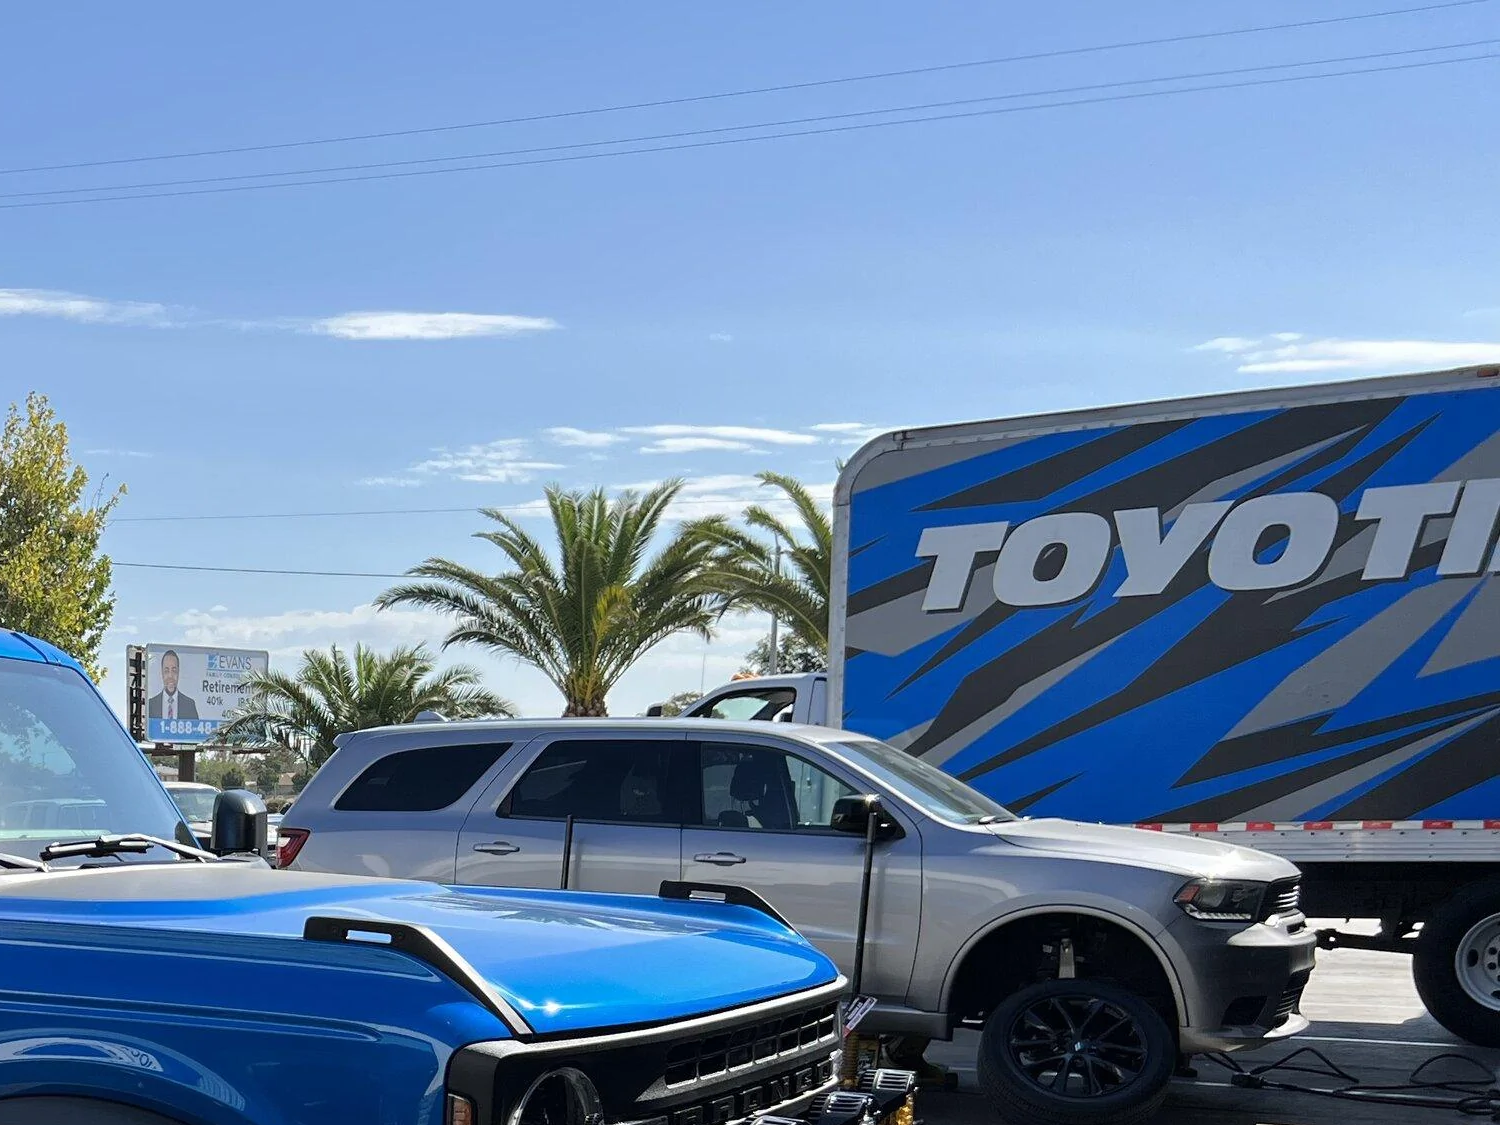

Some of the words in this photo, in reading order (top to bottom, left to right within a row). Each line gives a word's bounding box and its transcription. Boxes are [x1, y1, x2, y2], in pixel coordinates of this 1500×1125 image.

[915, 490, 1341, 615] TOYO
[1354, 478, 1500, 583] TI
[219, 653, 251, 670] EVANS
[206, 696, 224, 706] 401k
